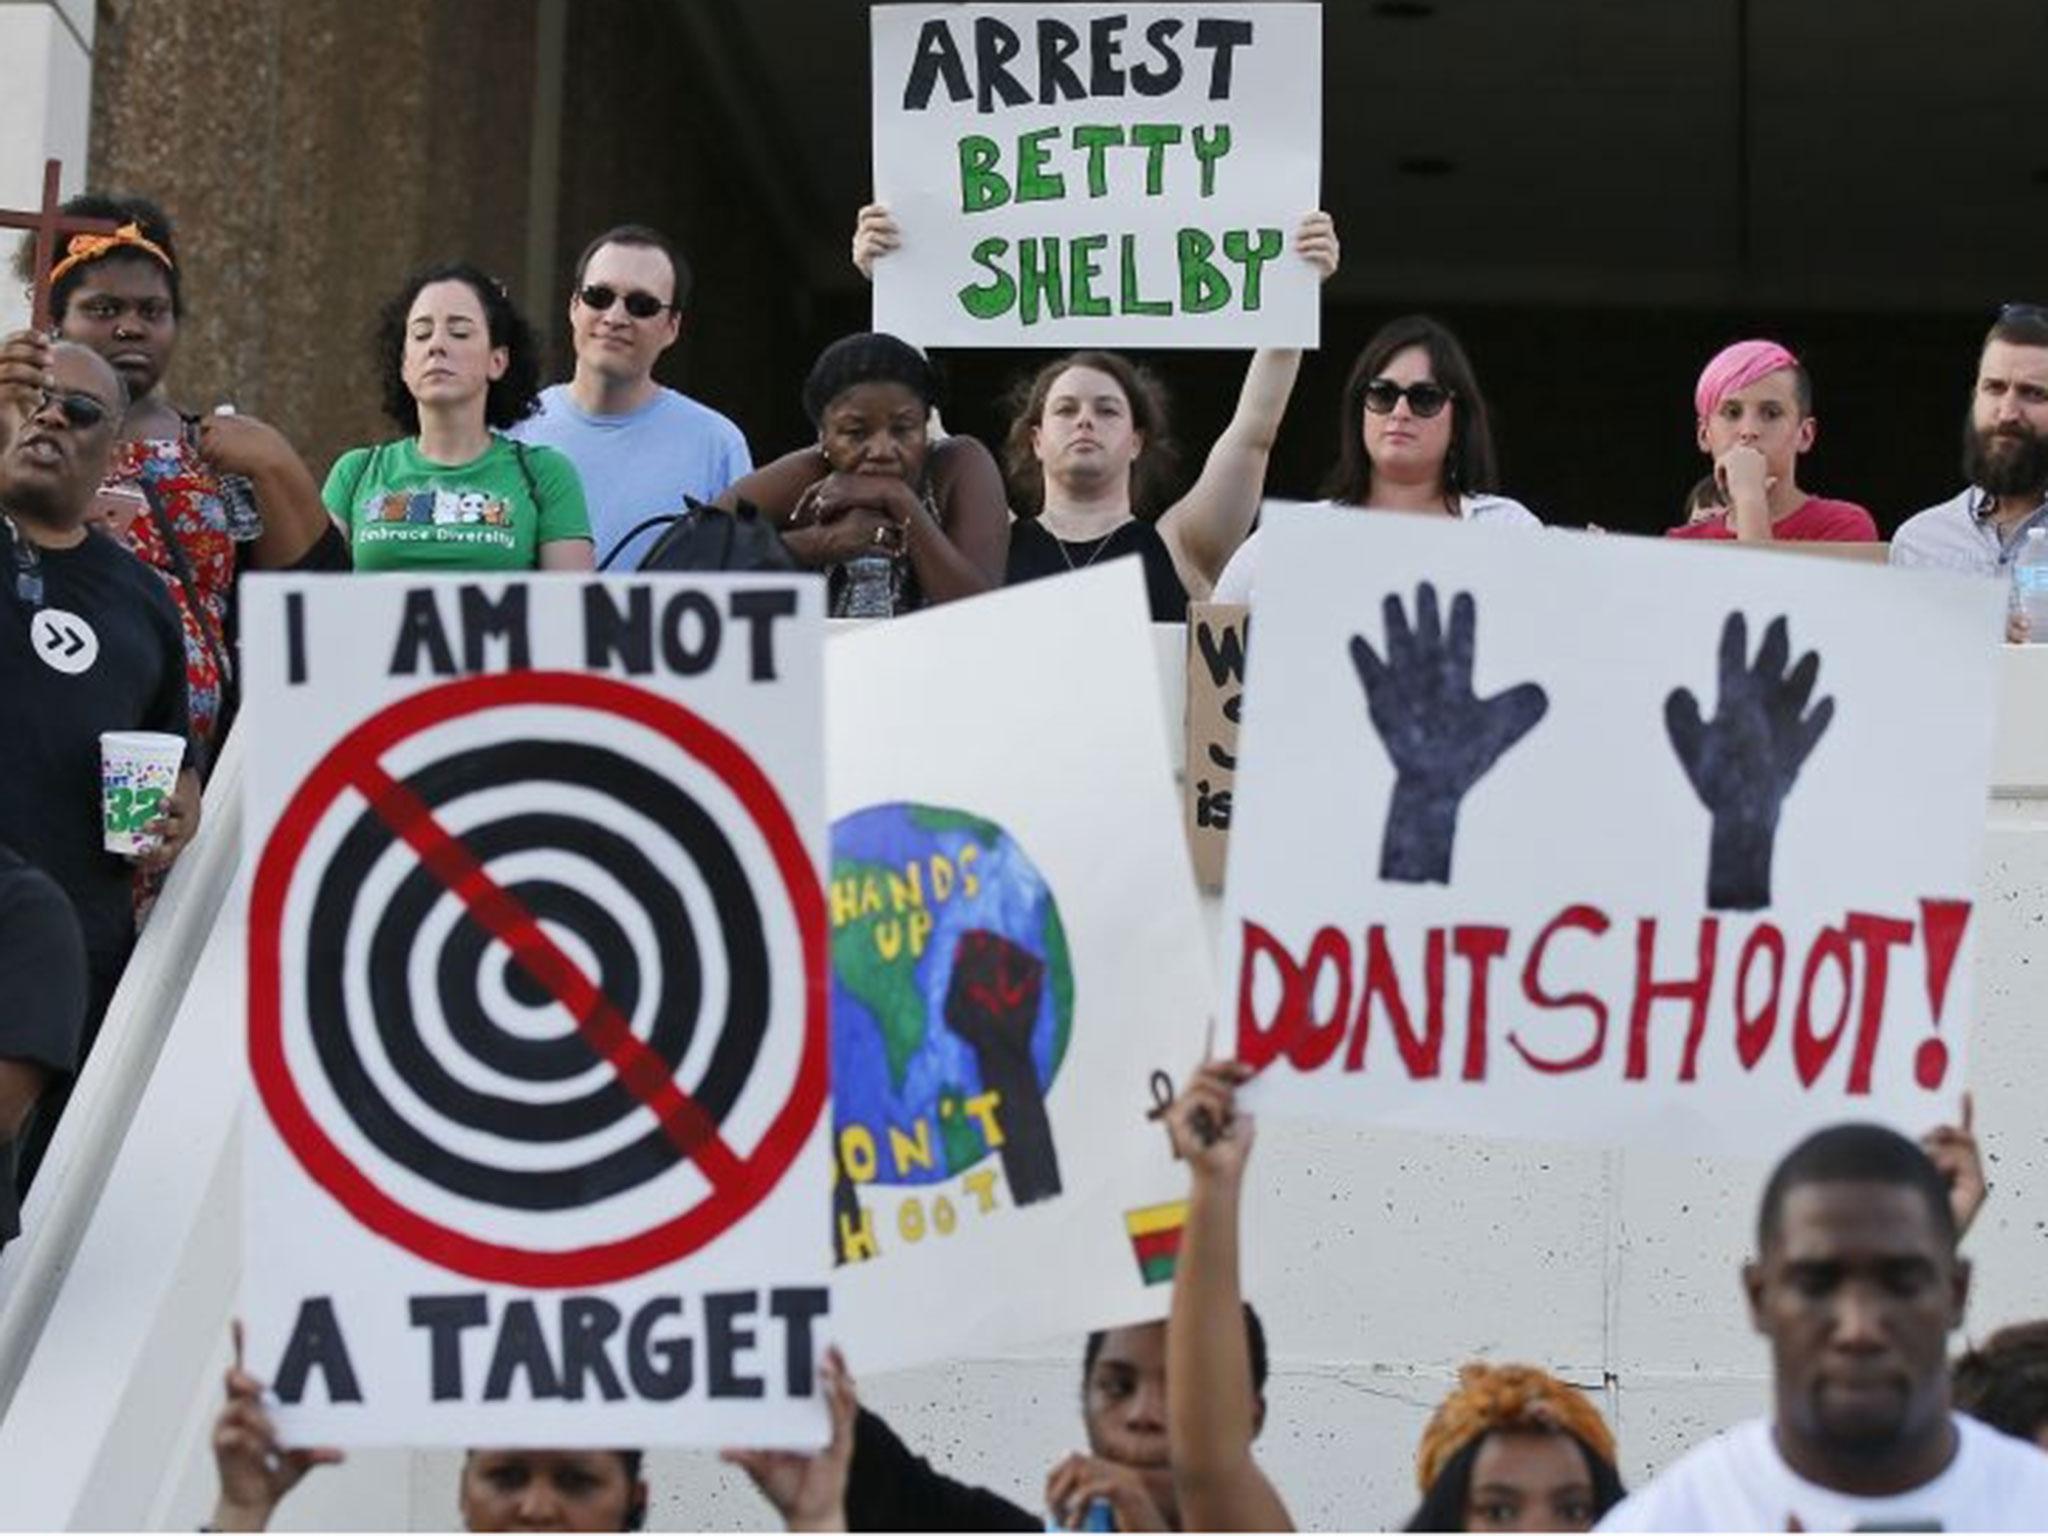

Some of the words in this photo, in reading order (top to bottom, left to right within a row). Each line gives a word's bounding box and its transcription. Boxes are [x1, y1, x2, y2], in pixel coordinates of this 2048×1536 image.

[903, 15, 1252, 113] ARREST
[958, 124, 1231, 213] BETTY
[958, 228, 1283, 325] SHELBY
[360, 526, 430, 543] Embrace
[436, 528, 515, 549] Diversity
[285, 591, 308, 685] I
[388, 583, 532, 675] AM
[583, 584, 798, 682] NOT
[832, 843, 979, 928] HANDS
[875, 910, 932, 960] UP
[828, 1090, 1005, 1183] ON'T
[839, 1170, 998, 1263] HOOT
[272, 1297, 363, 1404] A
[408, 1287, 829, 1402] TARGET
